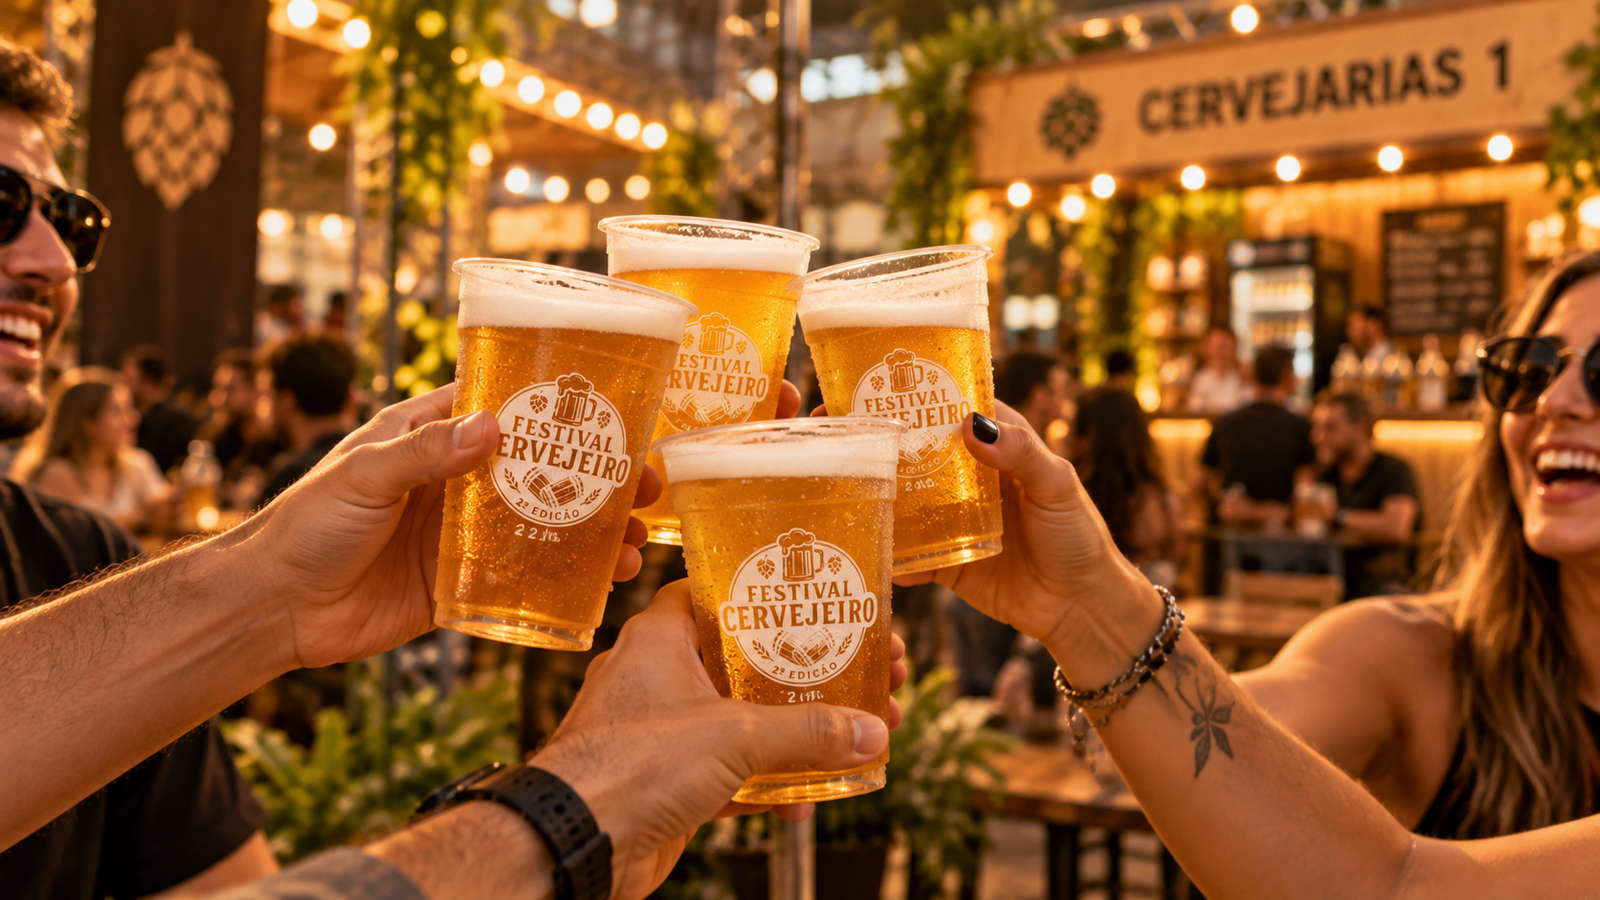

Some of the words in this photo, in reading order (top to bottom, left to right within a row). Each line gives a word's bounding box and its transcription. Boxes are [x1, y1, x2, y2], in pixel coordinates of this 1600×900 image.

[1138, 48, 1464, 134] CERVEJARIAS
[1488, 40, 1511, 90] 1
[678, 353, 752, 375] ESTIVAL
[666, 369, 767, 399] RVEJEIRO
[864, 388, 950, 413] FESTIVAL
[512, 415, 613, 454] FESTIVAL
[496, 432, 629, 484] ERVEJEIRO
[747, 580, 853, 603] FESTIVAL
[722, 597, 875, 632] CERVEJEIRO
